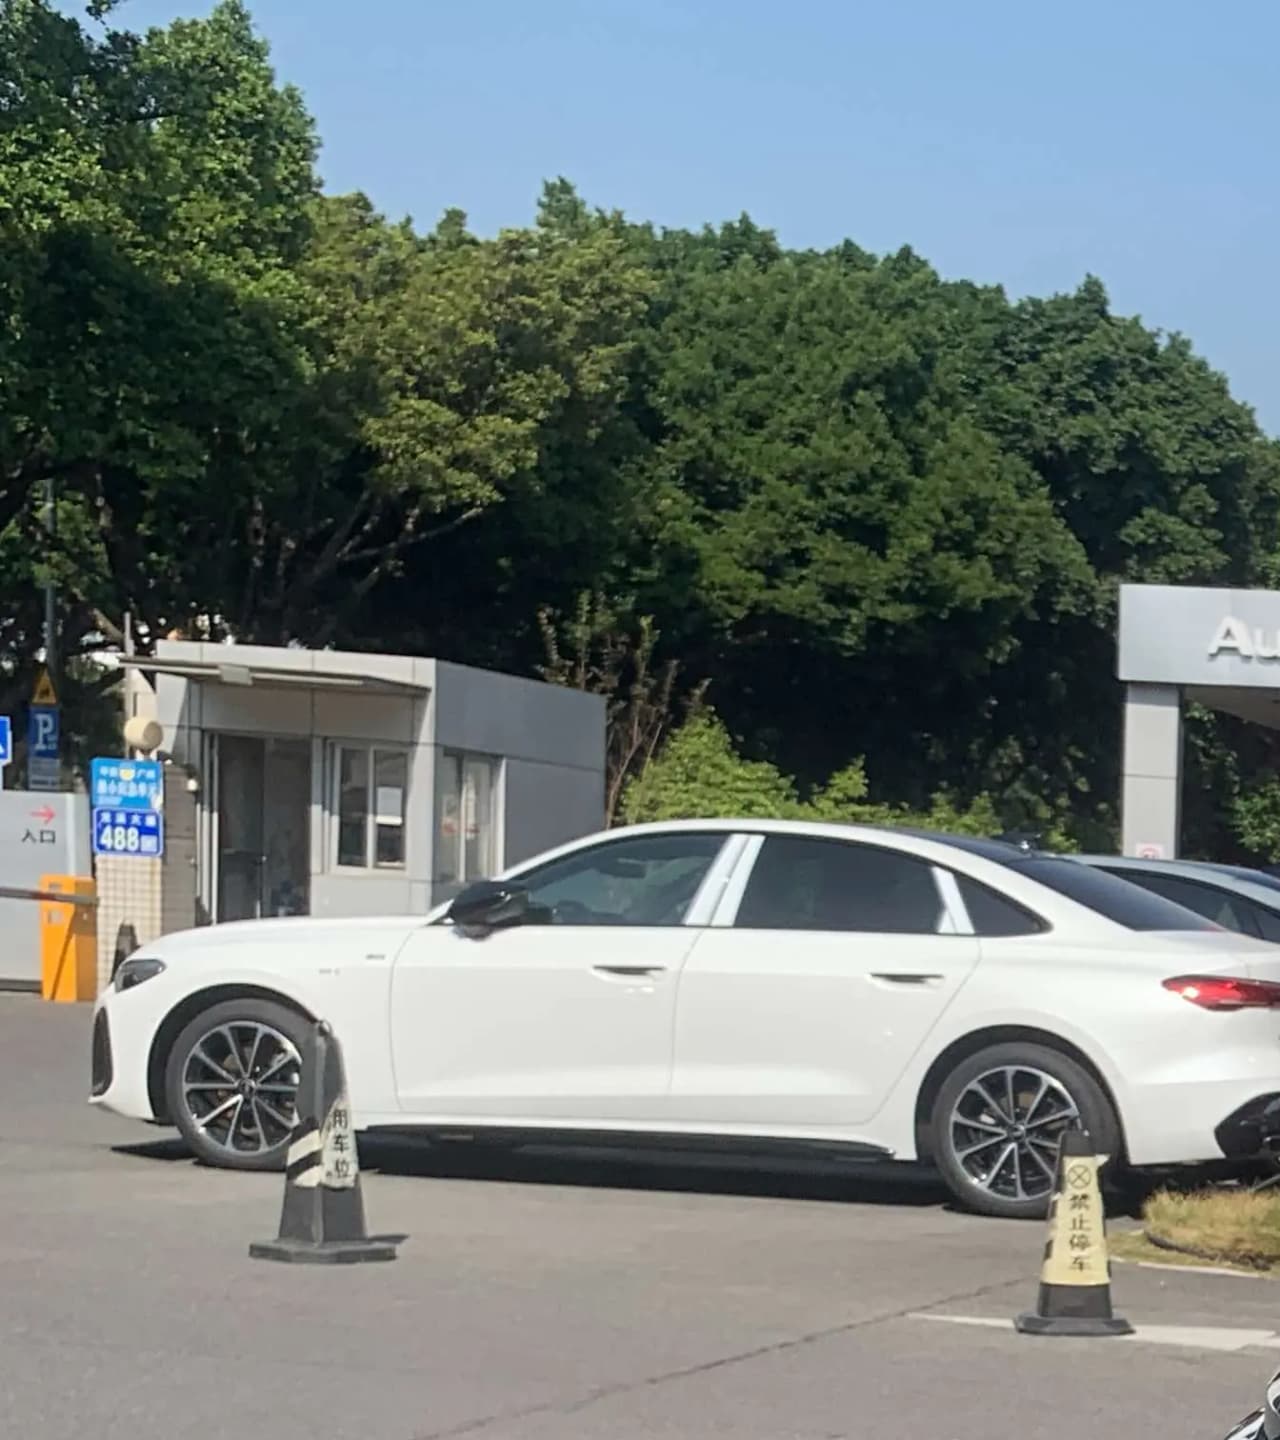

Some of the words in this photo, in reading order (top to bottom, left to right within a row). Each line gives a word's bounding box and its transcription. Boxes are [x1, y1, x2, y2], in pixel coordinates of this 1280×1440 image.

[21, 829, 56, 844] 入口
[100, 824, 139, 851] 488
[1068, 1194, 1093, 1271] 禁止停车
